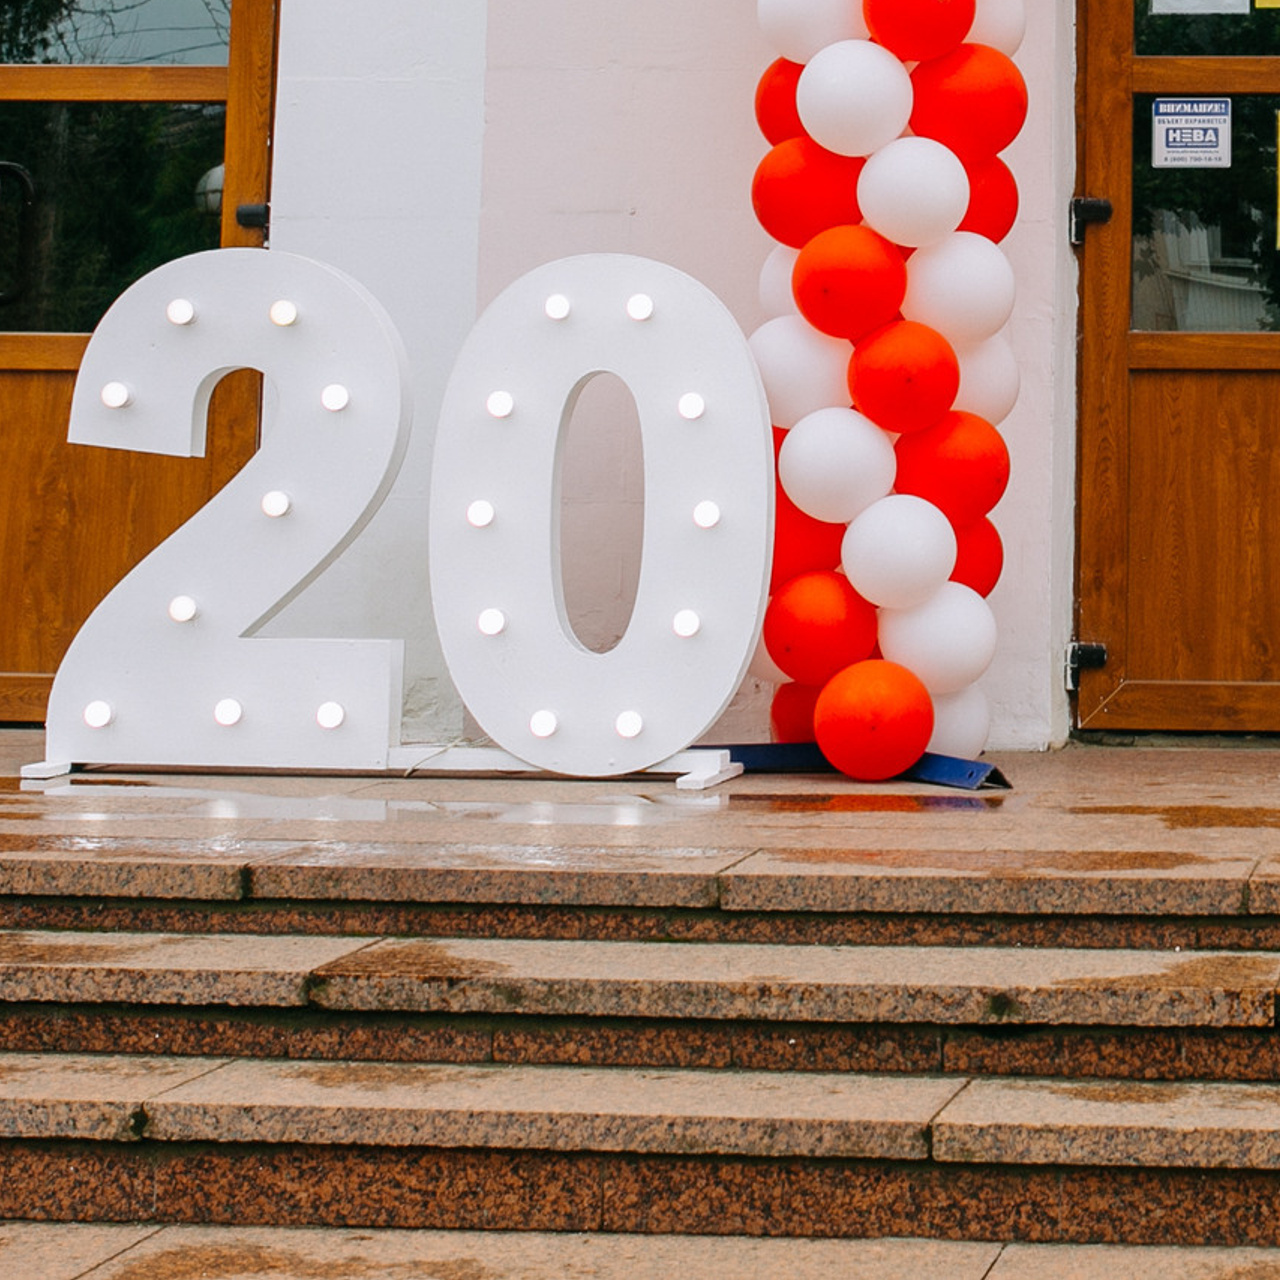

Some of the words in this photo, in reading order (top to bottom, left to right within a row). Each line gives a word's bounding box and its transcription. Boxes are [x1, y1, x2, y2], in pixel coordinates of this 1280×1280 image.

[1159, 103, 1226, 113] ВНИМАНИЕ!
[1168, 129, 1217, 142] НЕВА
[45, 247, 776, 777] 20
